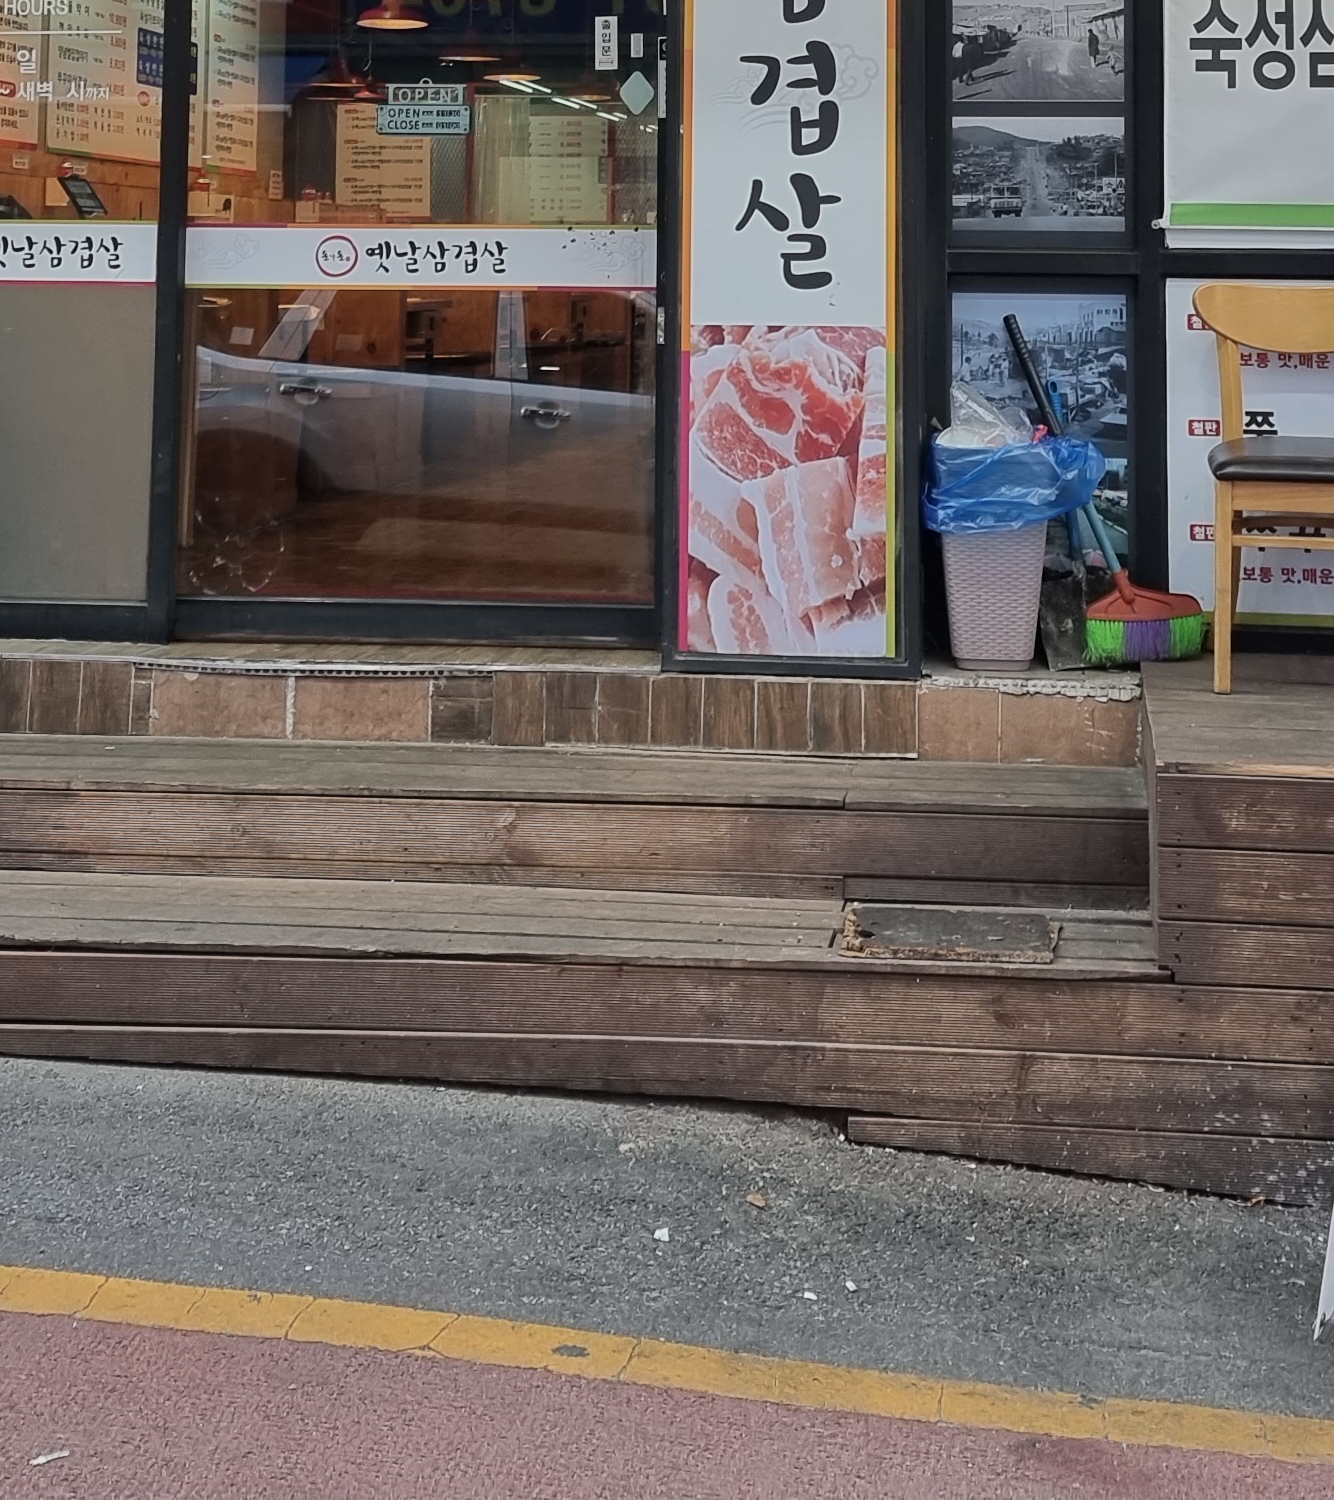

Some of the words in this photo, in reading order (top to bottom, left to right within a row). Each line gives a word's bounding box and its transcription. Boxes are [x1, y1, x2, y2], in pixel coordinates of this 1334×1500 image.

[16, 82, 54, 103] 새벽
[399, 88, 452, 103] OPEN
[388, 108, 420, 118] OPEN
[387, 120, 420, 130] CLOSE
[366, 241, 509, 274] 옛날삼겹살
[1240, 352, 1271, 369] 보통
[1278, 352, 1331, 370] 맛,매운
[1190, 421, 1219, 435] 철판
[1242, 566, 1273, 582] 보통
[1280, 566, 1334, 584] 맛,매운
